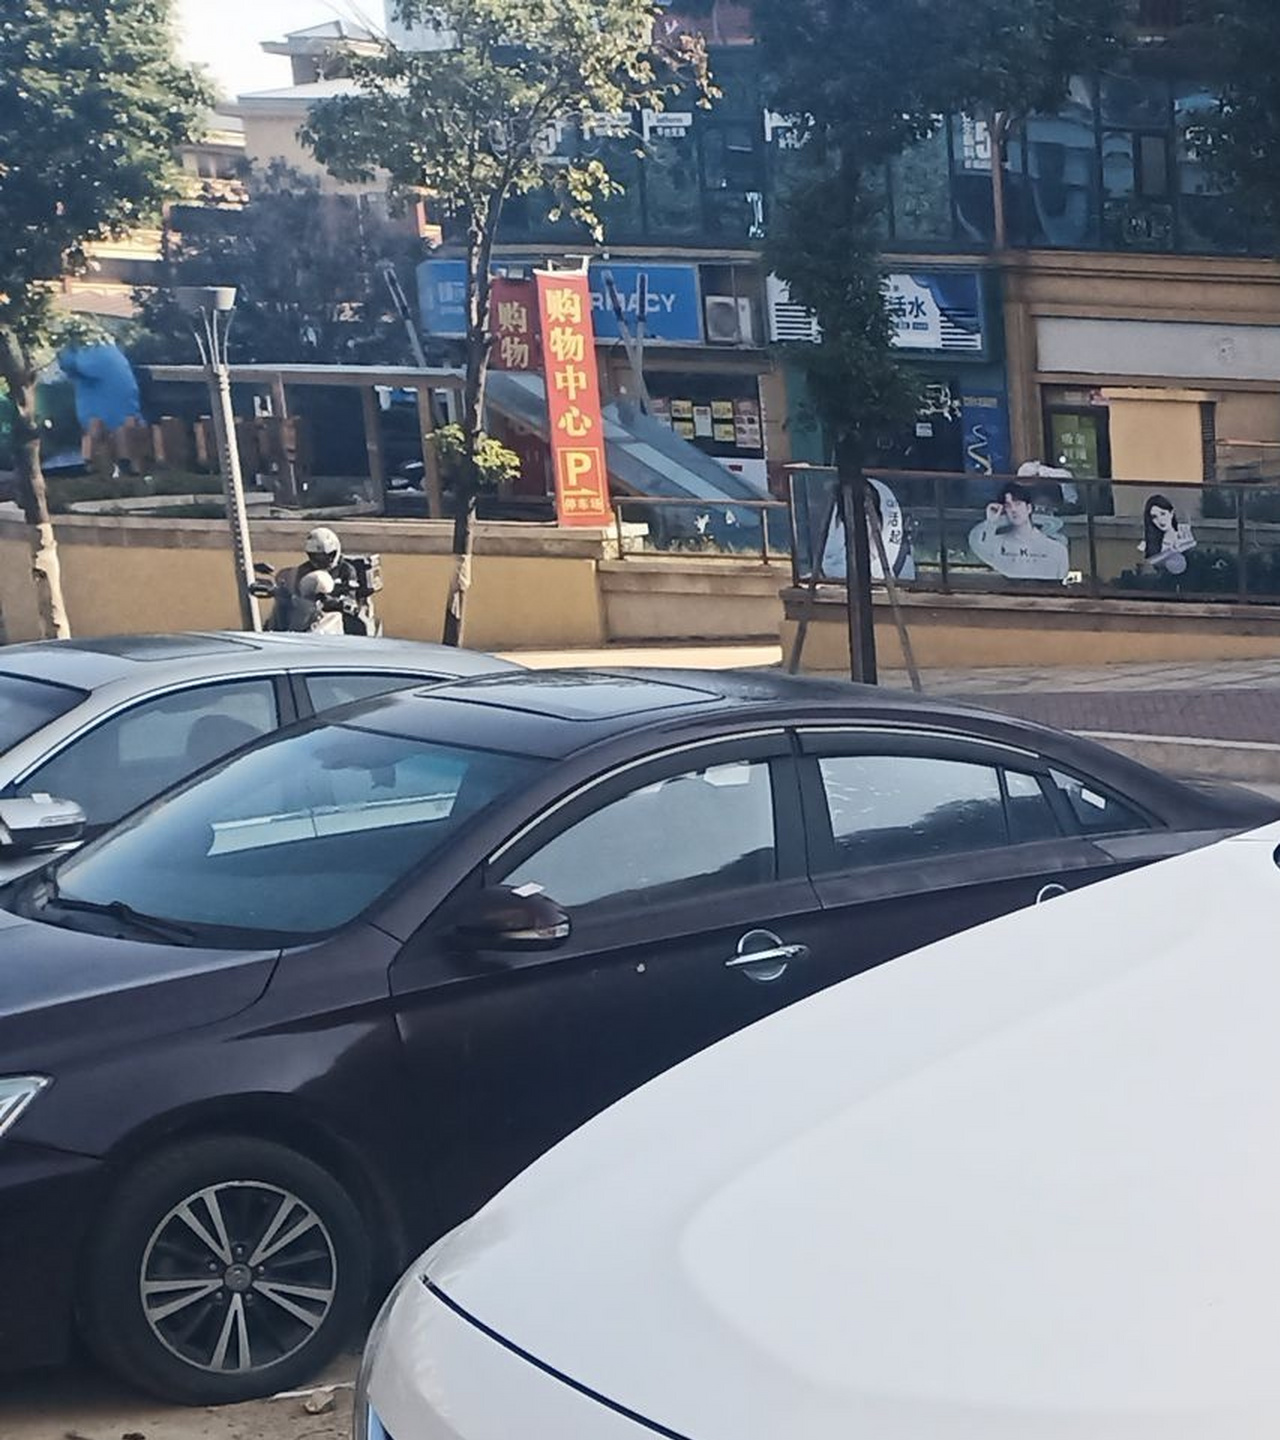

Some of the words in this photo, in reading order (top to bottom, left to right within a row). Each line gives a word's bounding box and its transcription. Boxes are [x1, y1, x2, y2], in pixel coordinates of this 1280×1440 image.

[545, 288, 593, 437] 购物中心
[566, 451, 592, 487] P
